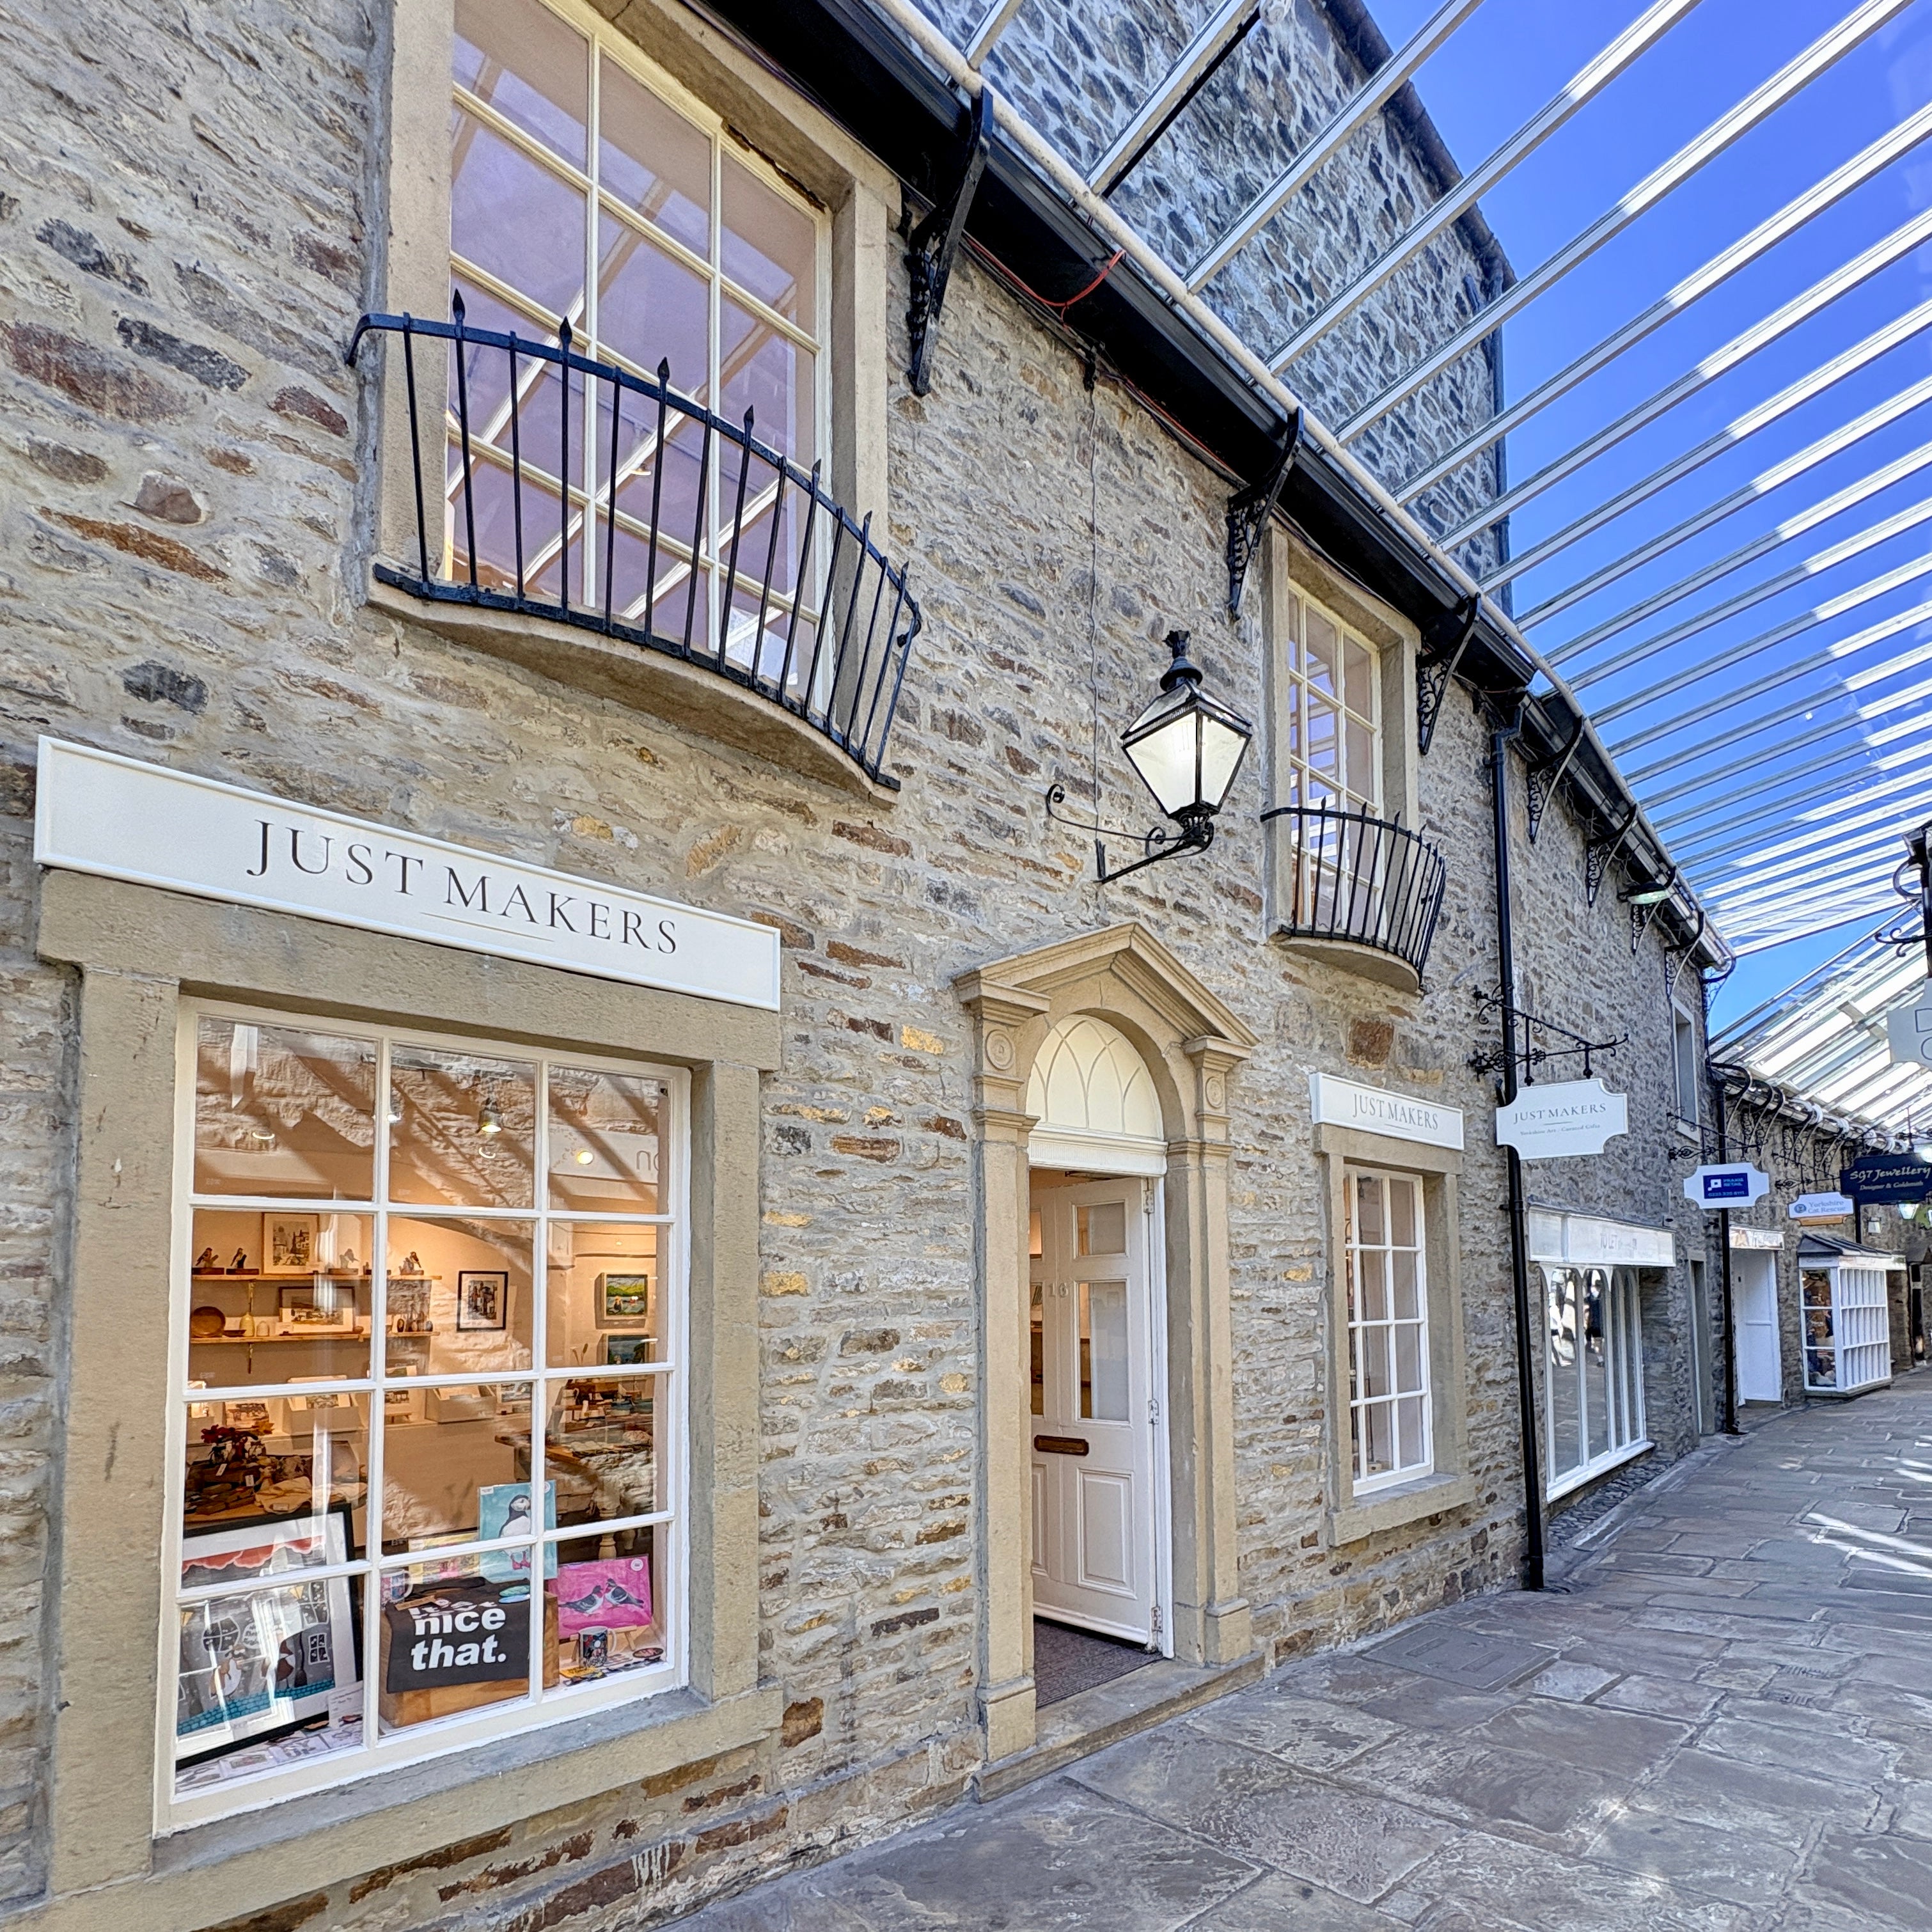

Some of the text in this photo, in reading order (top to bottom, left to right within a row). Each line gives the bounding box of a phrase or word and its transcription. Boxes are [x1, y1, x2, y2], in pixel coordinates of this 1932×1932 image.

[247, 820, 678, 954] JUST MAKERS
[1353, 1094, 1438, 1129] JUST MAKERS
[1514, 1103, 1606, 1124] JUST MAKERS
[1873, 1166, 1931, 1182] Jewellery
[414, 1608, 506, 1636] nice
[411, 1634, 507, 1670] that.
